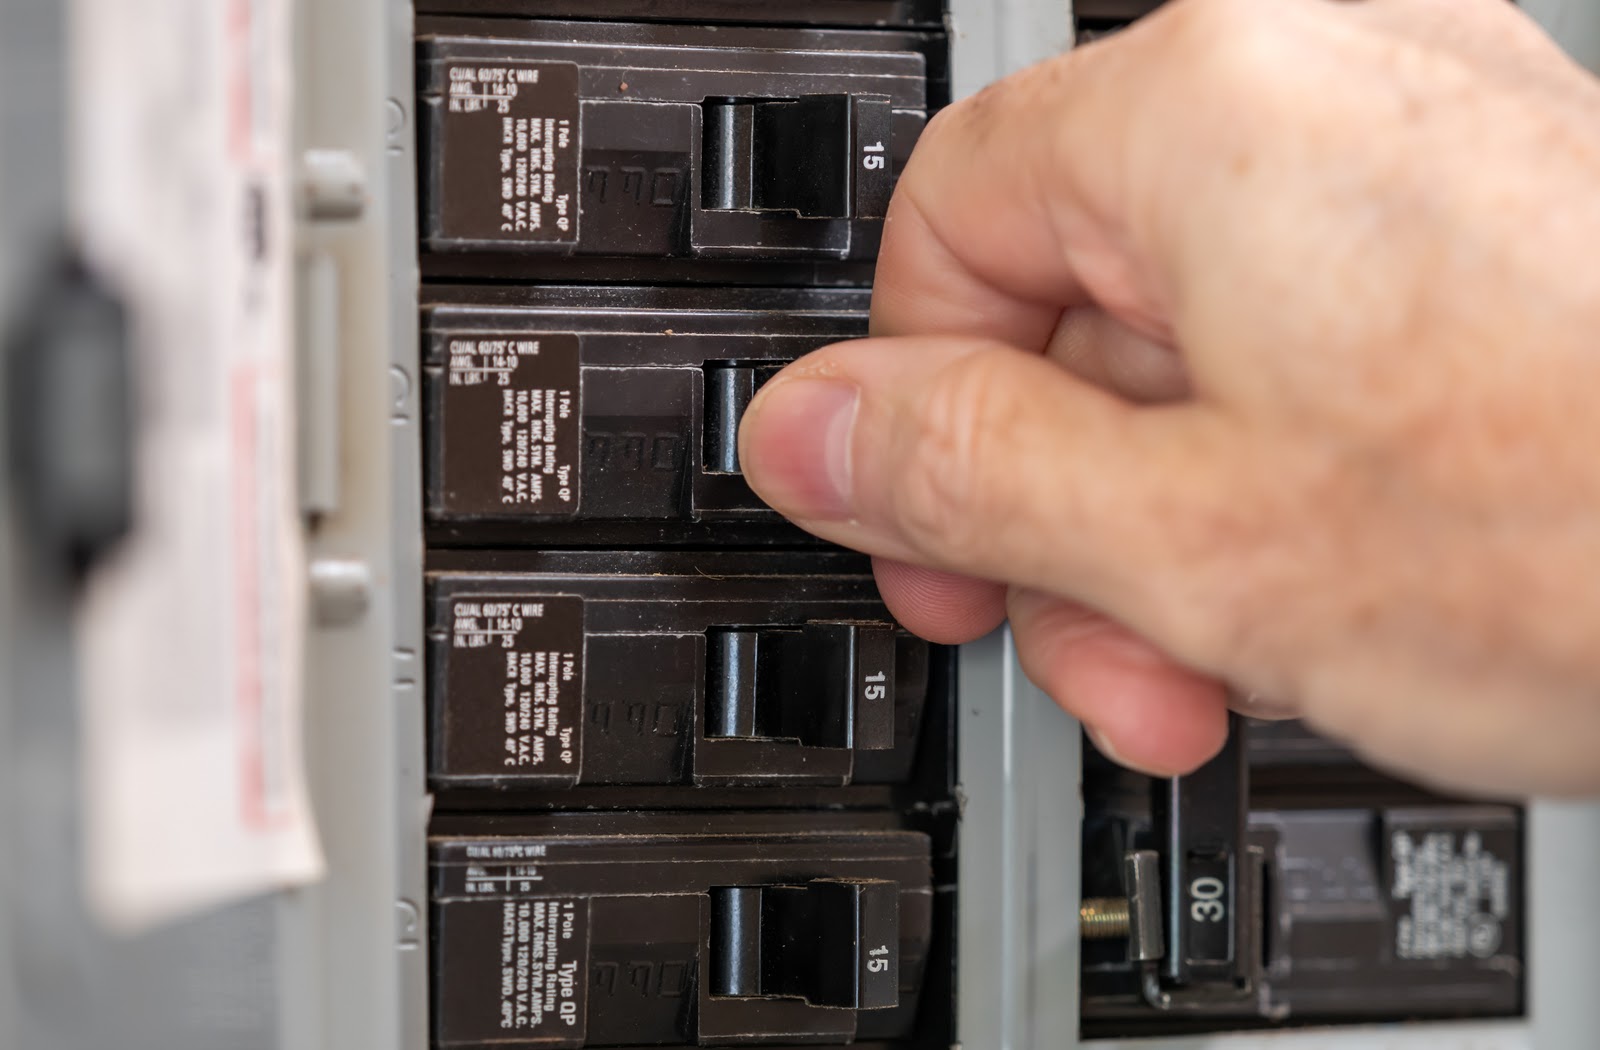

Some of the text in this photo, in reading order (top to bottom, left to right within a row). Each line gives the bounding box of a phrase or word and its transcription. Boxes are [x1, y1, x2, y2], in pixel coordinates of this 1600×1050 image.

[516, 69, 539, 83] WIRE
[515, 118, 528, 152] 10,000
[530, 118, 542, 144] MAX.
[558, 128, 570, 148] Pole
[542, 118, 555, 203] Interrupting Rating
[863, 141, 885, 170] 15
[515, 157, 528, 197] 120/240
[529, 201, 541, 232] AMPS.
[556, 193, 569, 216] Type
[556, 217, 569, 232] QP
[516, 341, 540, 355] WIRE
[516, 390, 528, 423] 10,000
[531, 389, 542, 415] MAX.
[559, 398, 570, 418] Pole
[543, 389, 556, 474] Interrupting Rating
[516, 429, 528, 468] 120/240
[531, 473, 542, 503] AMPS.
[557, 465, 570, 486] Type
[558, 488, 570, 502] QP
[521, 604, 544, 617] WIRE
[519, 652, 532, 686] 10,000
[535, 651, 546, 677] MAX.
[563, 660, 574, 681] Pole
[545, 652, 559, 736] Interrupting Rating
[864, 670, 886, 700] 15
[519, 691, 531, 730] 120/240
[533, 735, 544, 766] AMPS.
[560, 727, 572, 748] Type
[560, 750, 572, 764] QP
[1190, 877, 1225, 922] 30
[562, 912, 574, 939] Pole
[516, 945, 529, 991] 120/240
[544, 902, 559, 1011] Interrupting Rating
[866, 945, 889, 973] 15
[558, 960, 577, 997] Type
[560, 1002, 576, 1026] QP
